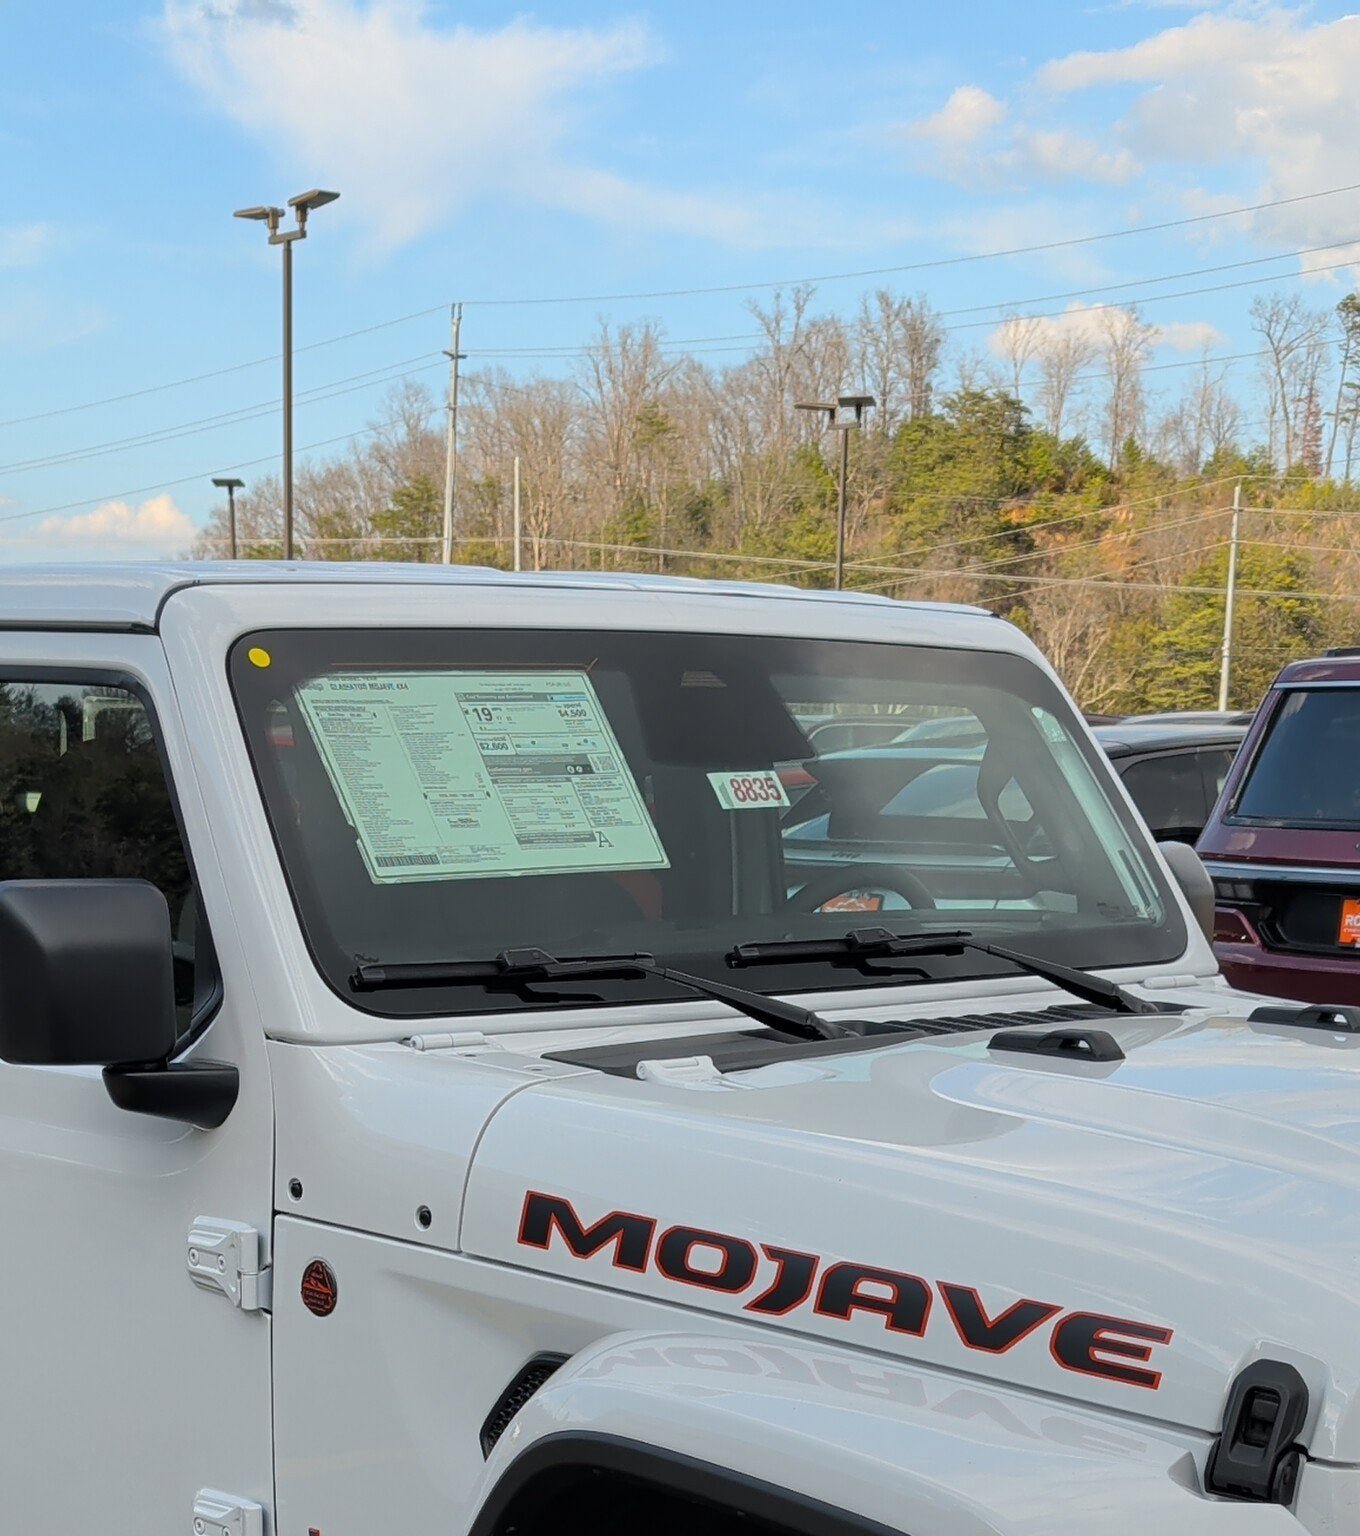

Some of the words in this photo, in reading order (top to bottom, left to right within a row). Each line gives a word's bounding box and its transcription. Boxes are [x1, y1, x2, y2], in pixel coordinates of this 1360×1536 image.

[472, 707, 493, 721] 19
[730, 777, 782, 802] 8835
[595, 831, 614, 848] A
[518, 1190, 1174, 1390] MOJAVE
